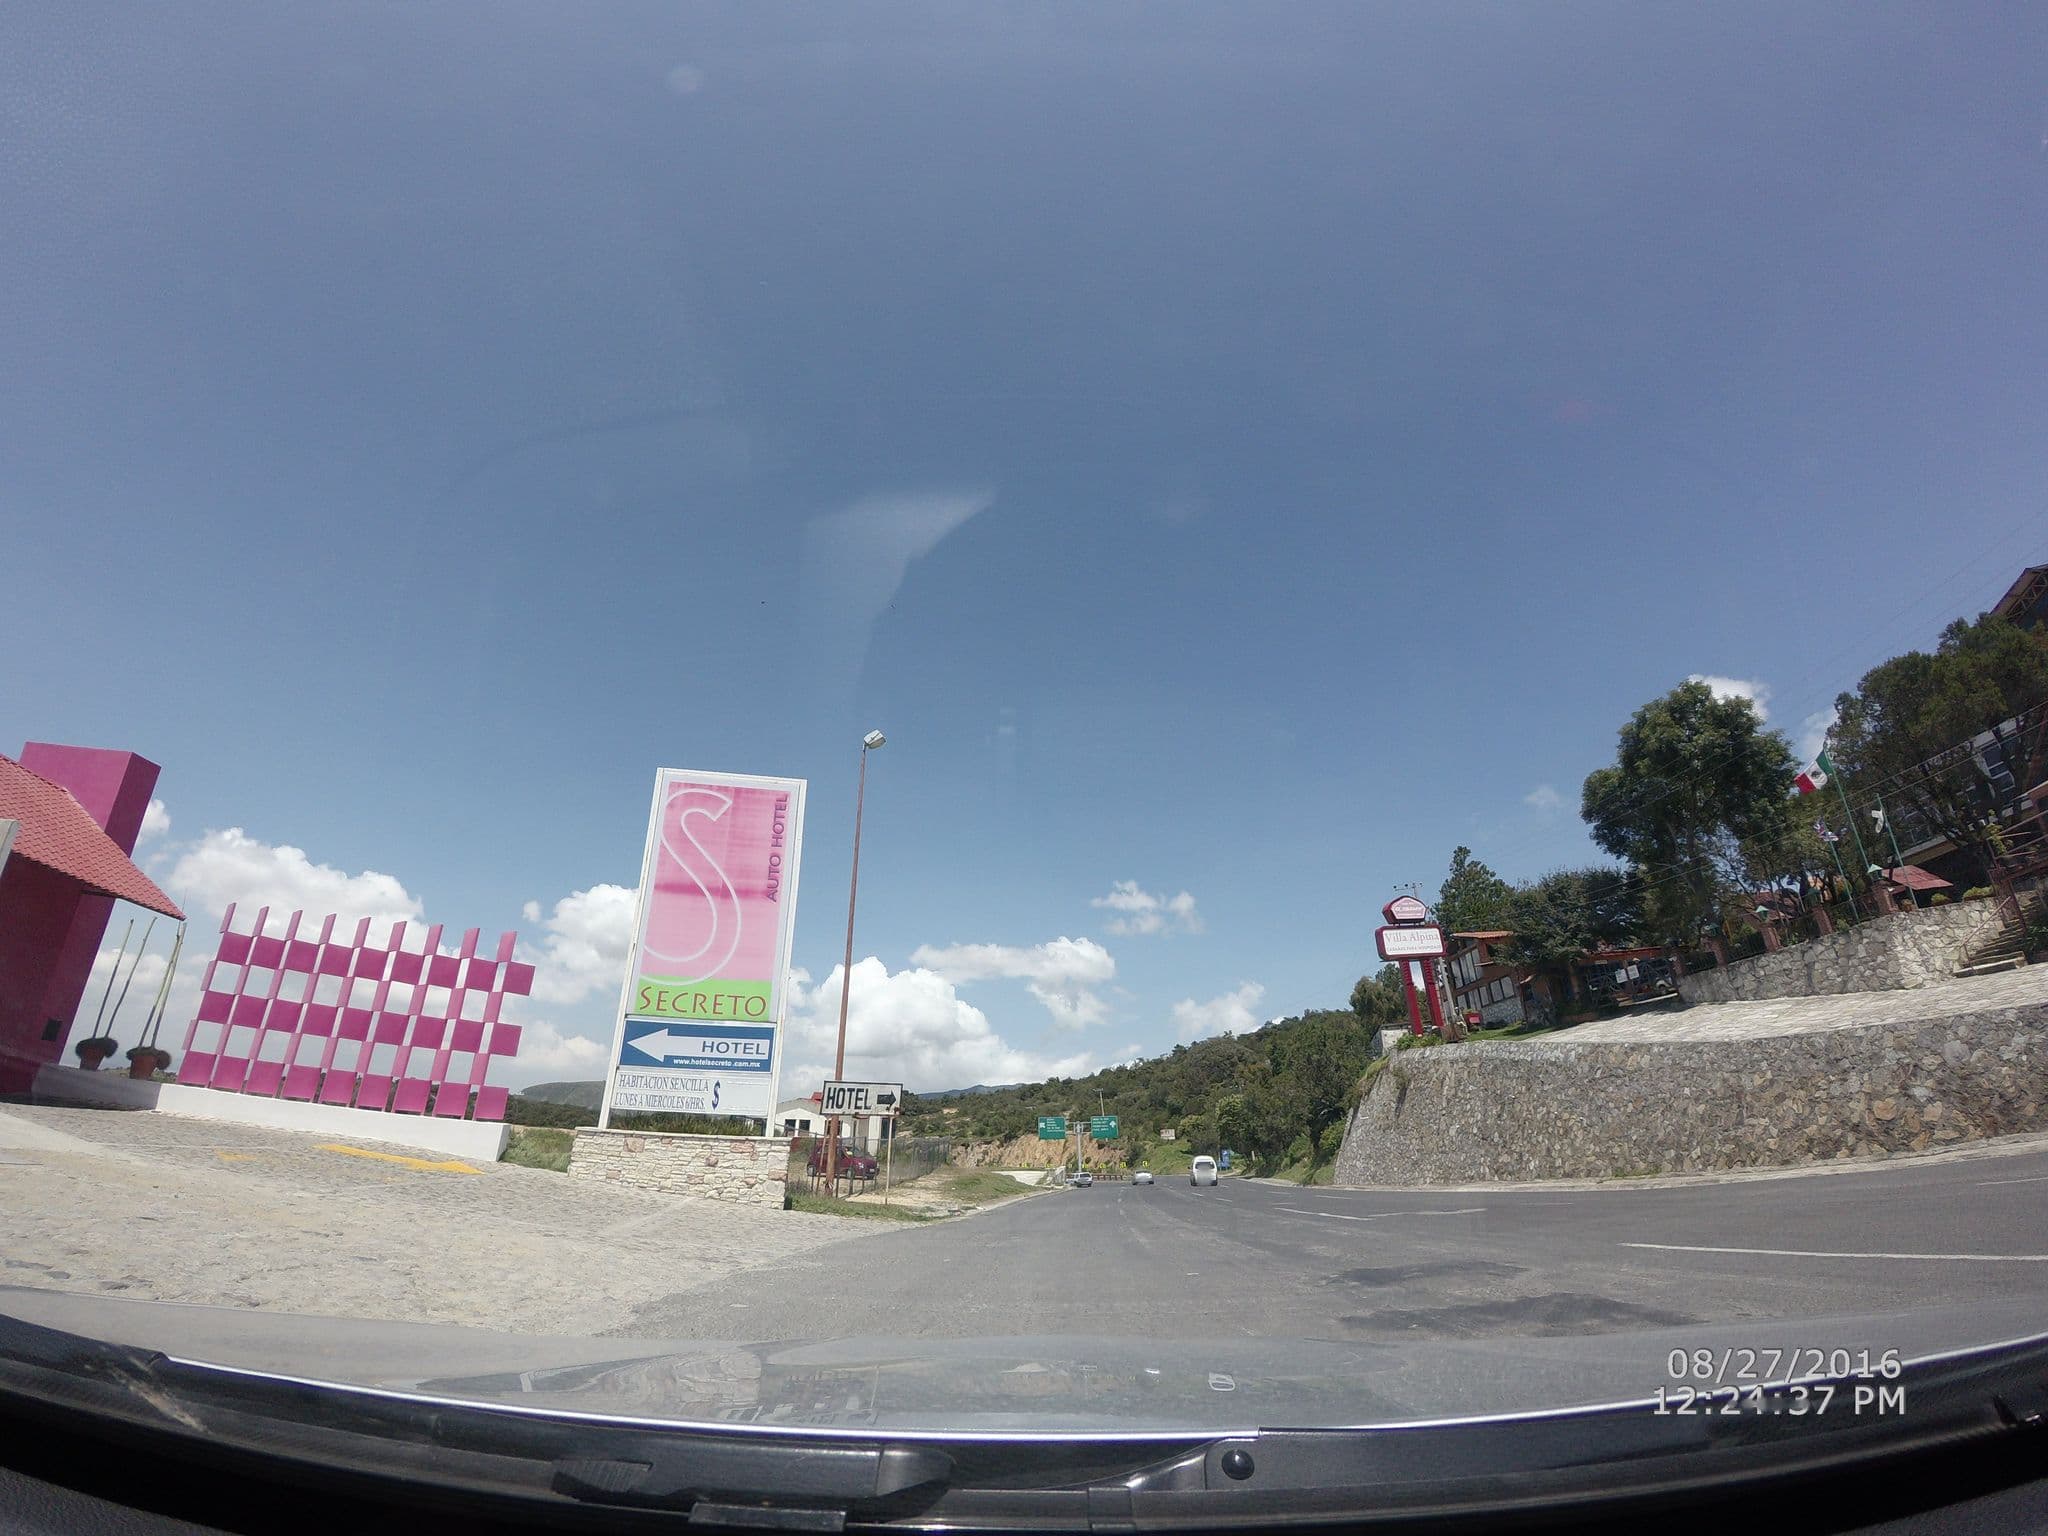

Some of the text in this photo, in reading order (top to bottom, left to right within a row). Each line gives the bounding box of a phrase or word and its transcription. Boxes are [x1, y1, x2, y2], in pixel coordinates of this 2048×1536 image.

[766, 794, 788, 902] AUTO HOTEL
[1385, 931, 1440, 944] Villa Alpina
[639, 986, 767, 1017] SECRETO
[701, 1040, 766, 1055] HOTEL
[618, 1074, 709, 1092] HABITACION SENCILLA
[614, 1092, 637, 1106] LUNES
[645, 1093, 685, 1109] MIERCOLES
[825, 1087, 872, 1110] HOTEL
